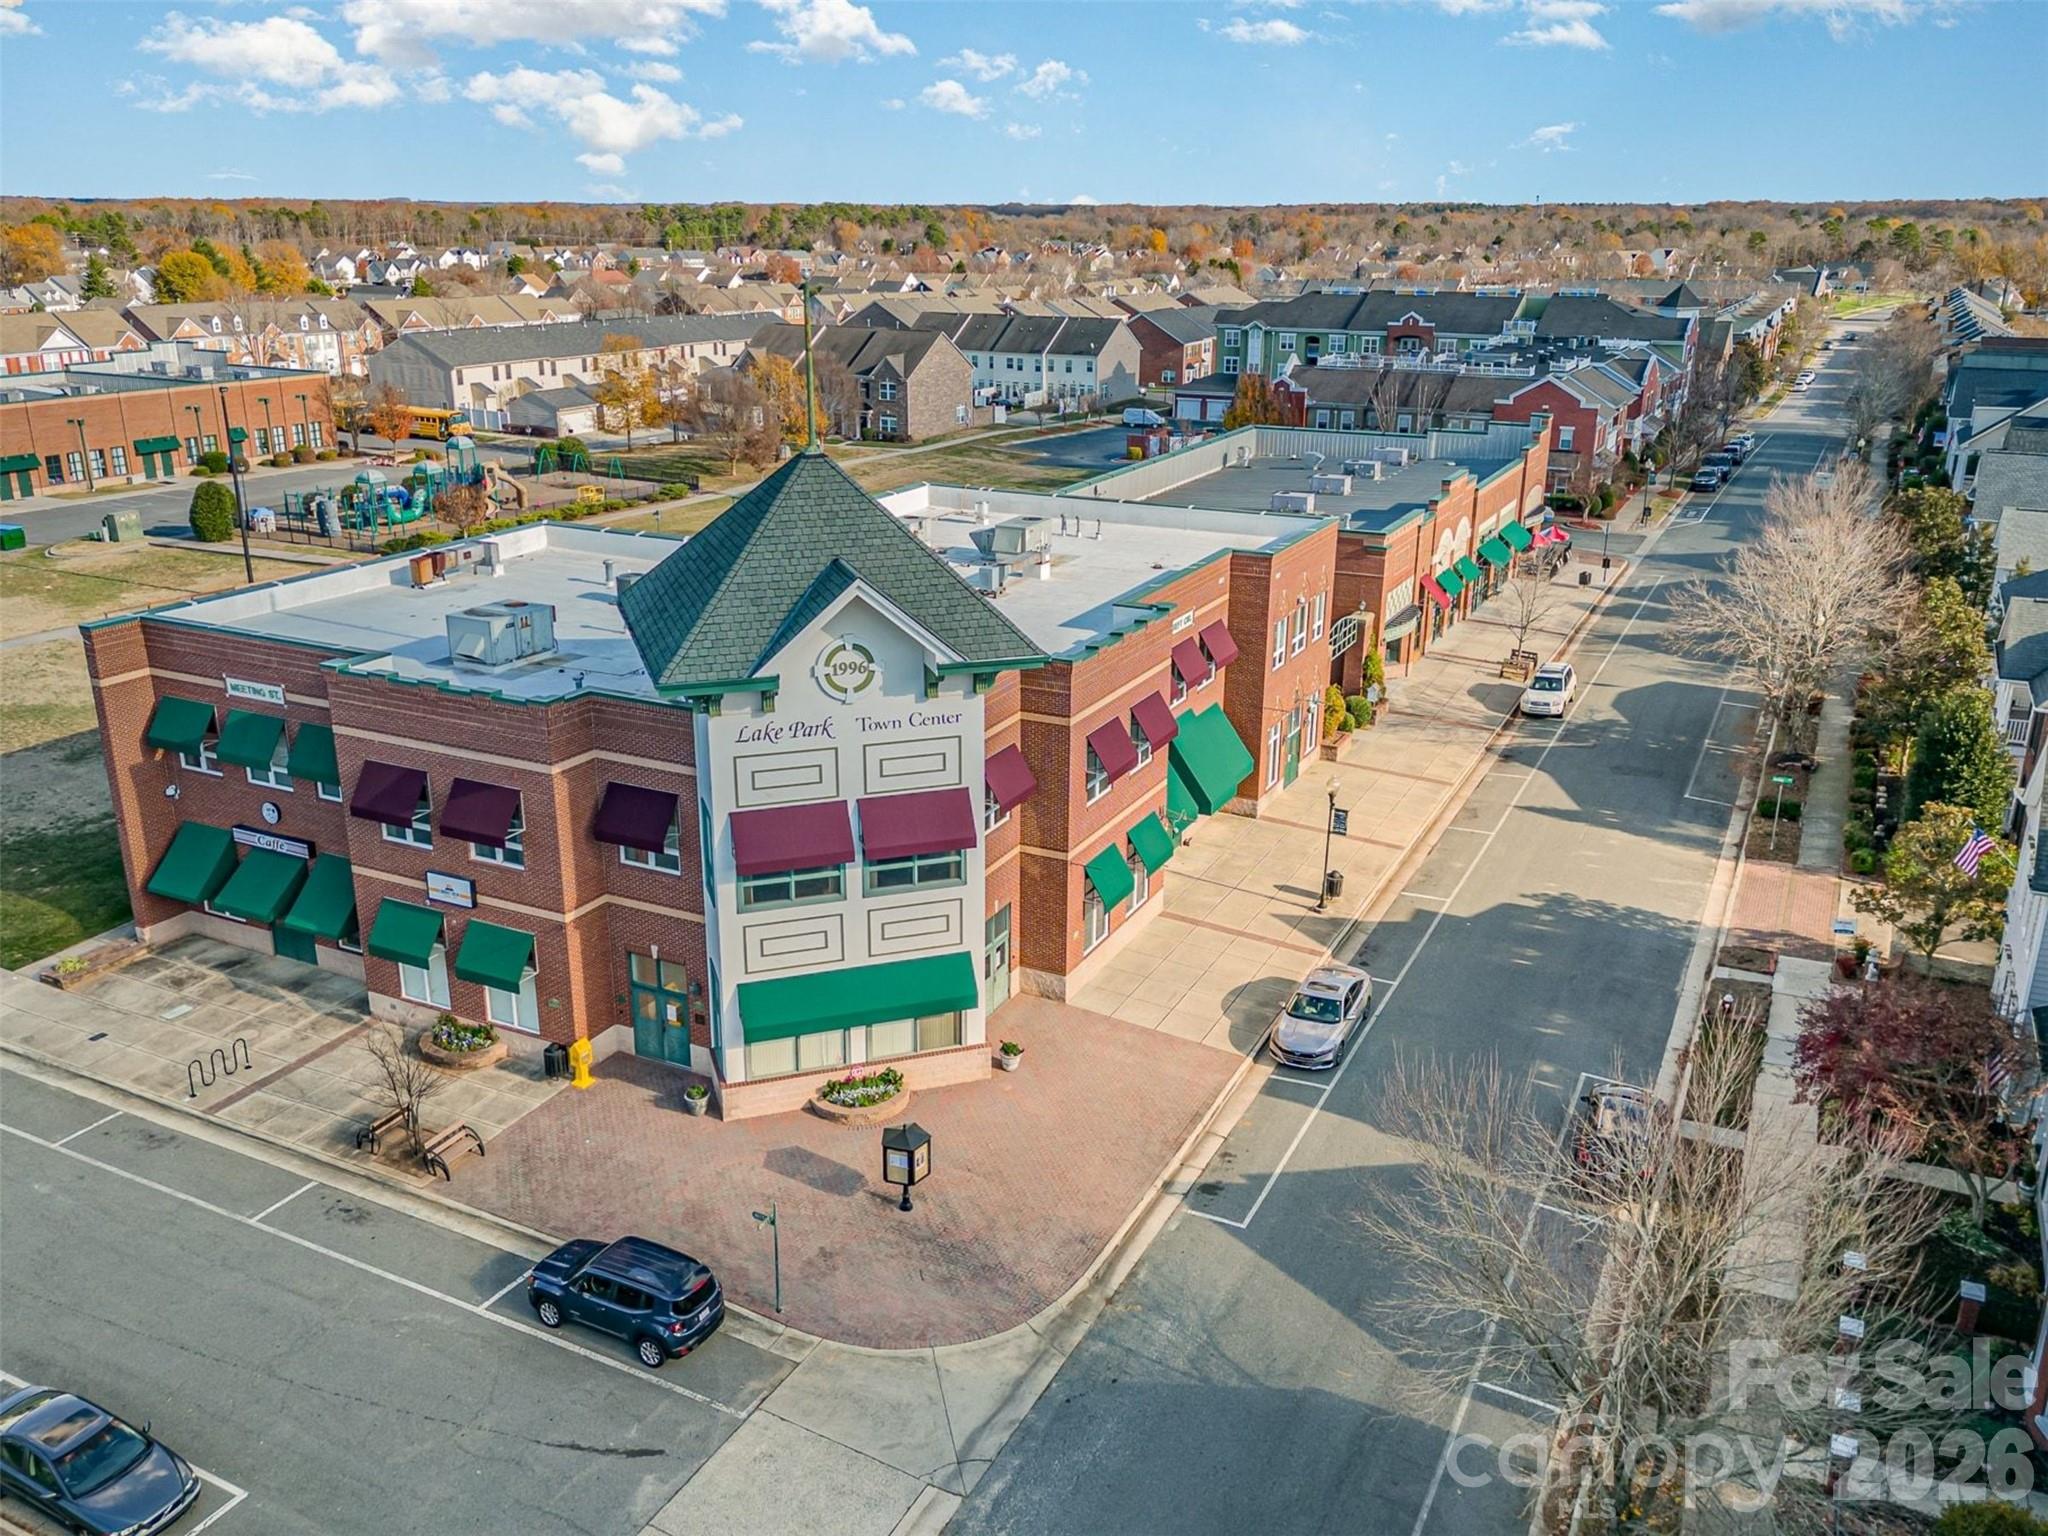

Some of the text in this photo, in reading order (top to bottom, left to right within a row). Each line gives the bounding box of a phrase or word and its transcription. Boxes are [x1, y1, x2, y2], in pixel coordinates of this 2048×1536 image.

[831, 661, 867, 676] 1996
[735, 711, 963, 744] Lake Park Town Center
